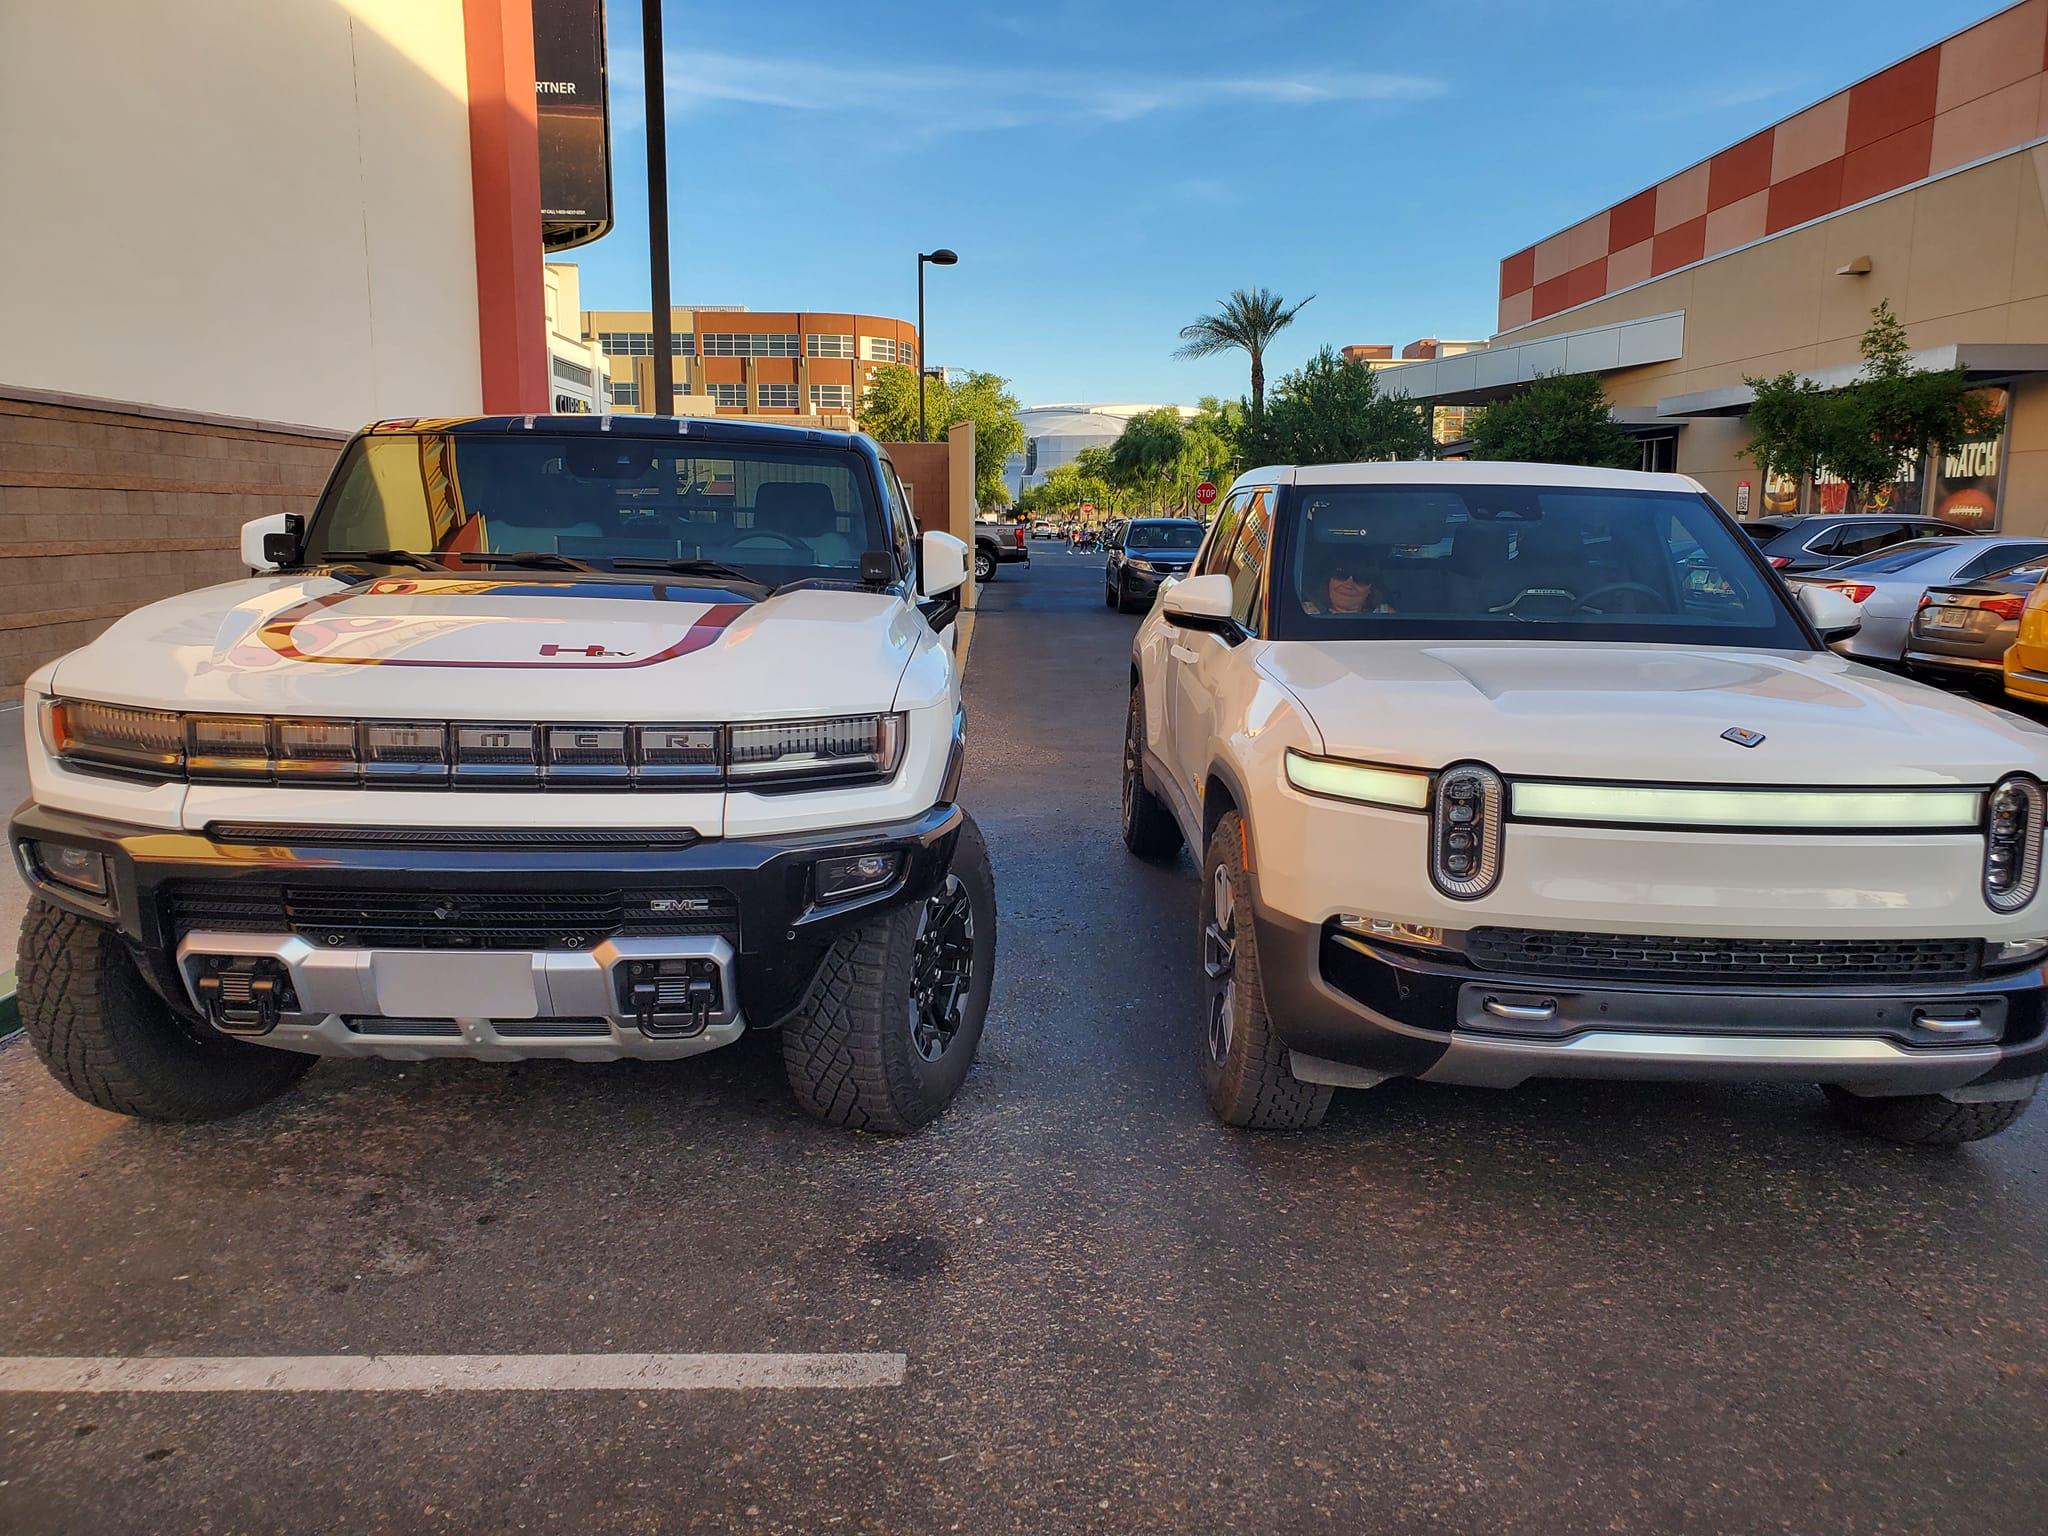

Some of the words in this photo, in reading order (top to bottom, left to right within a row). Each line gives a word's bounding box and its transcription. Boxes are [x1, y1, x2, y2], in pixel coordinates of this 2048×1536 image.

[535, 81, 576, 95] RTNER
[1944, 441, 1998, 479] WATCH
[1196, 489, 1216, 498] STOP
[650, 899, 709, 911] GMC
